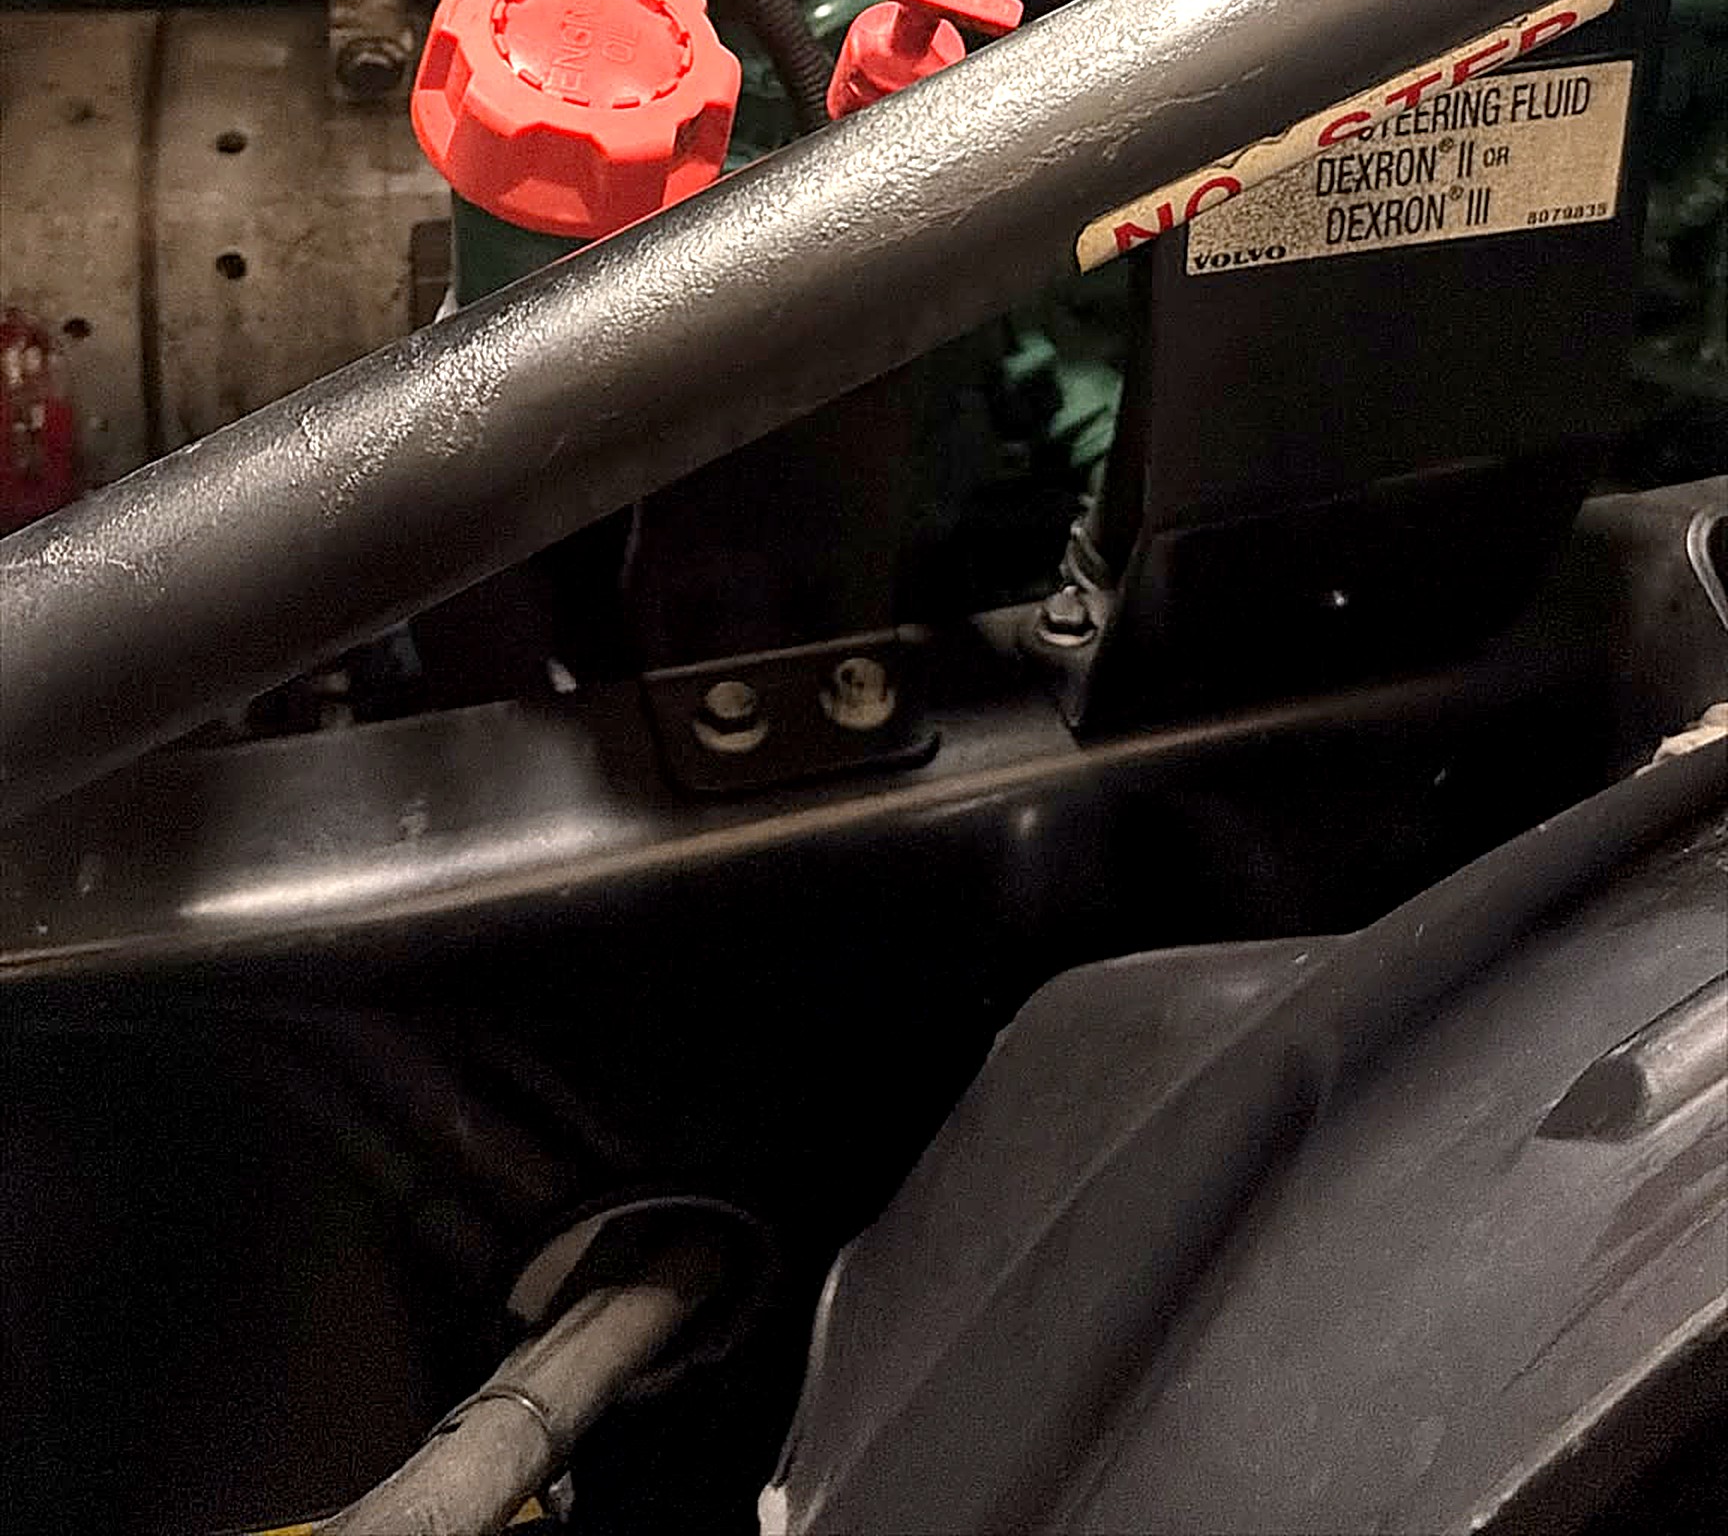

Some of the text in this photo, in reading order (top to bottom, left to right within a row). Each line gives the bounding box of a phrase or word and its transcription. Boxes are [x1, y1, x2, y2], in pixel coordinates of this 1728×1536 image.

[601, 23, 641, 65] OIL
[1511, 76, 1592, 123] FLUID
[1457, 140, 1475, 179] II
[1482, 146, 1510, 168] OR
[1466, 187, 1491, 226] III
[1193, 245, 1287, 270] VOLVO
